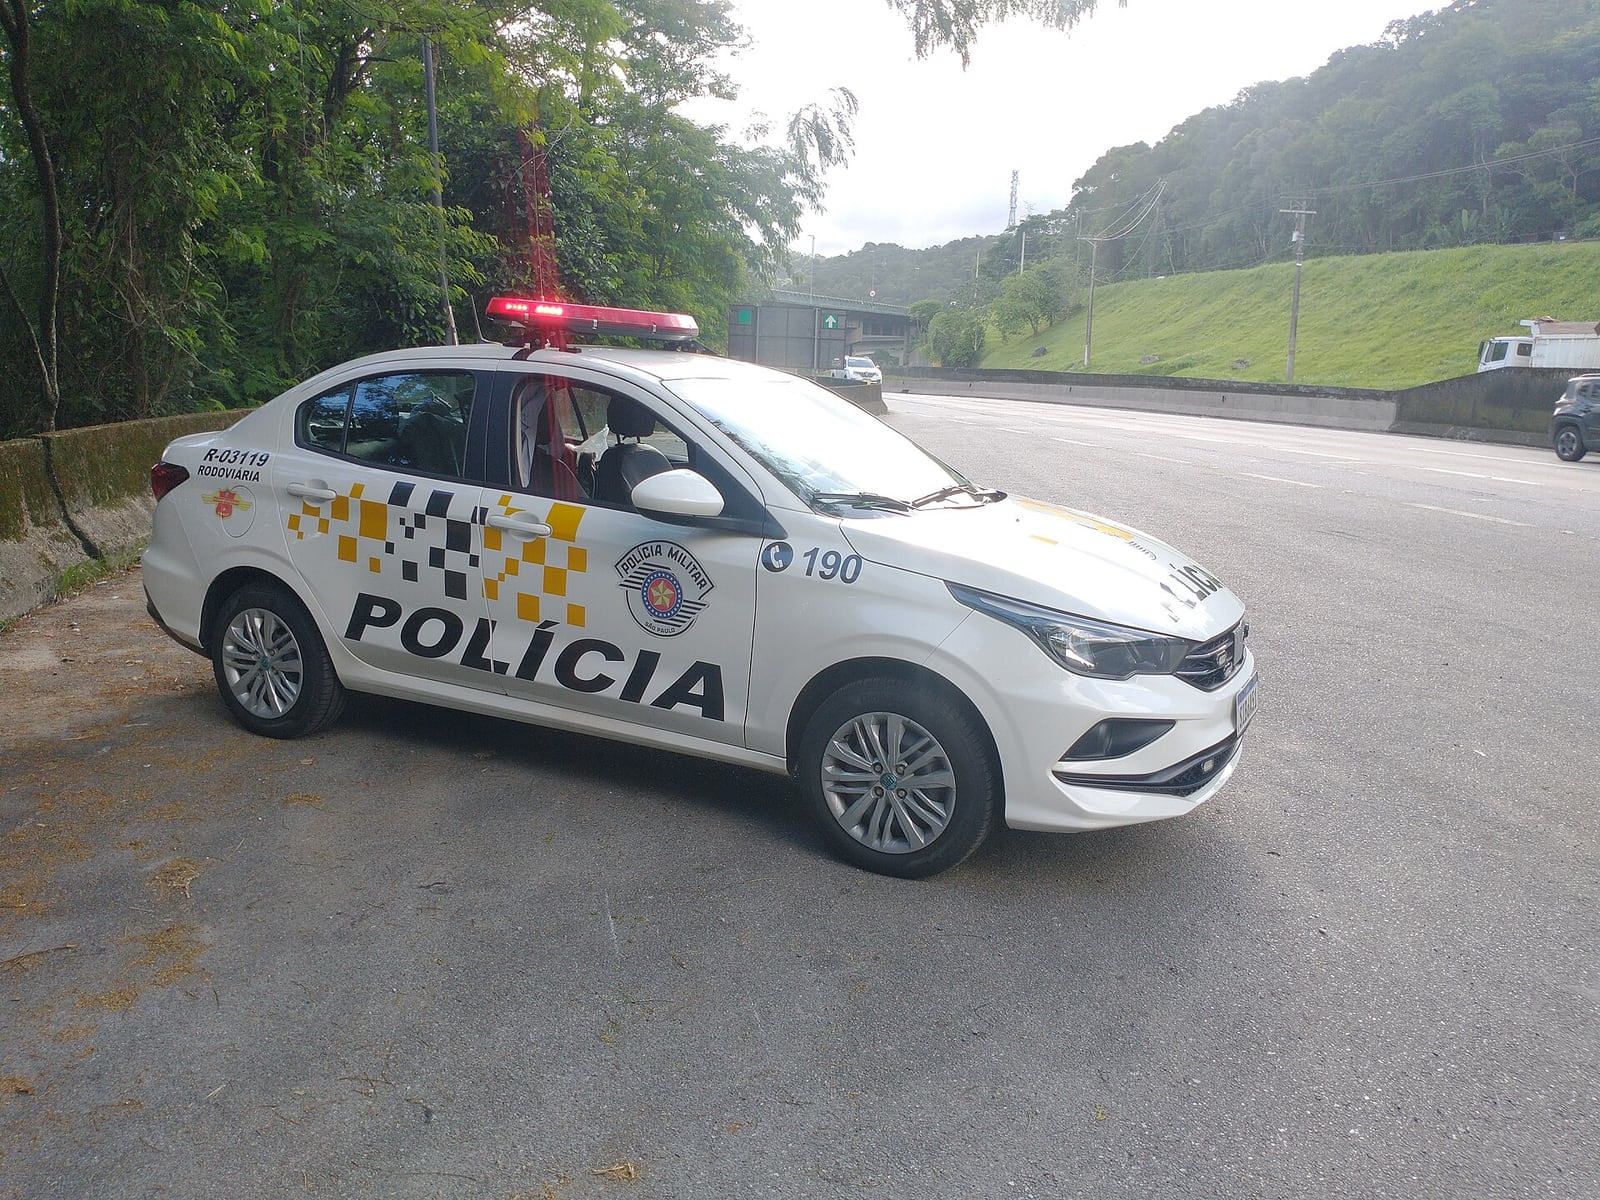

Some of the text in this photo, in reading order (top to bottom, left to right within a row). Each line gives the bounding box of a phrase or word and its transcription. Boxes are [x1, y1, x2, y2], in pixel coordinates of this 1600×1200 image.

[197, 465, 260, 482] RODOVIÁRIA
[203, 448, 270, 466] R-03119
[622, 544, 708, 590] POLÍCIA MILITAR
[803, 547, 863, 584] 190
[344, 592, 725, 722] POLÍCIA
